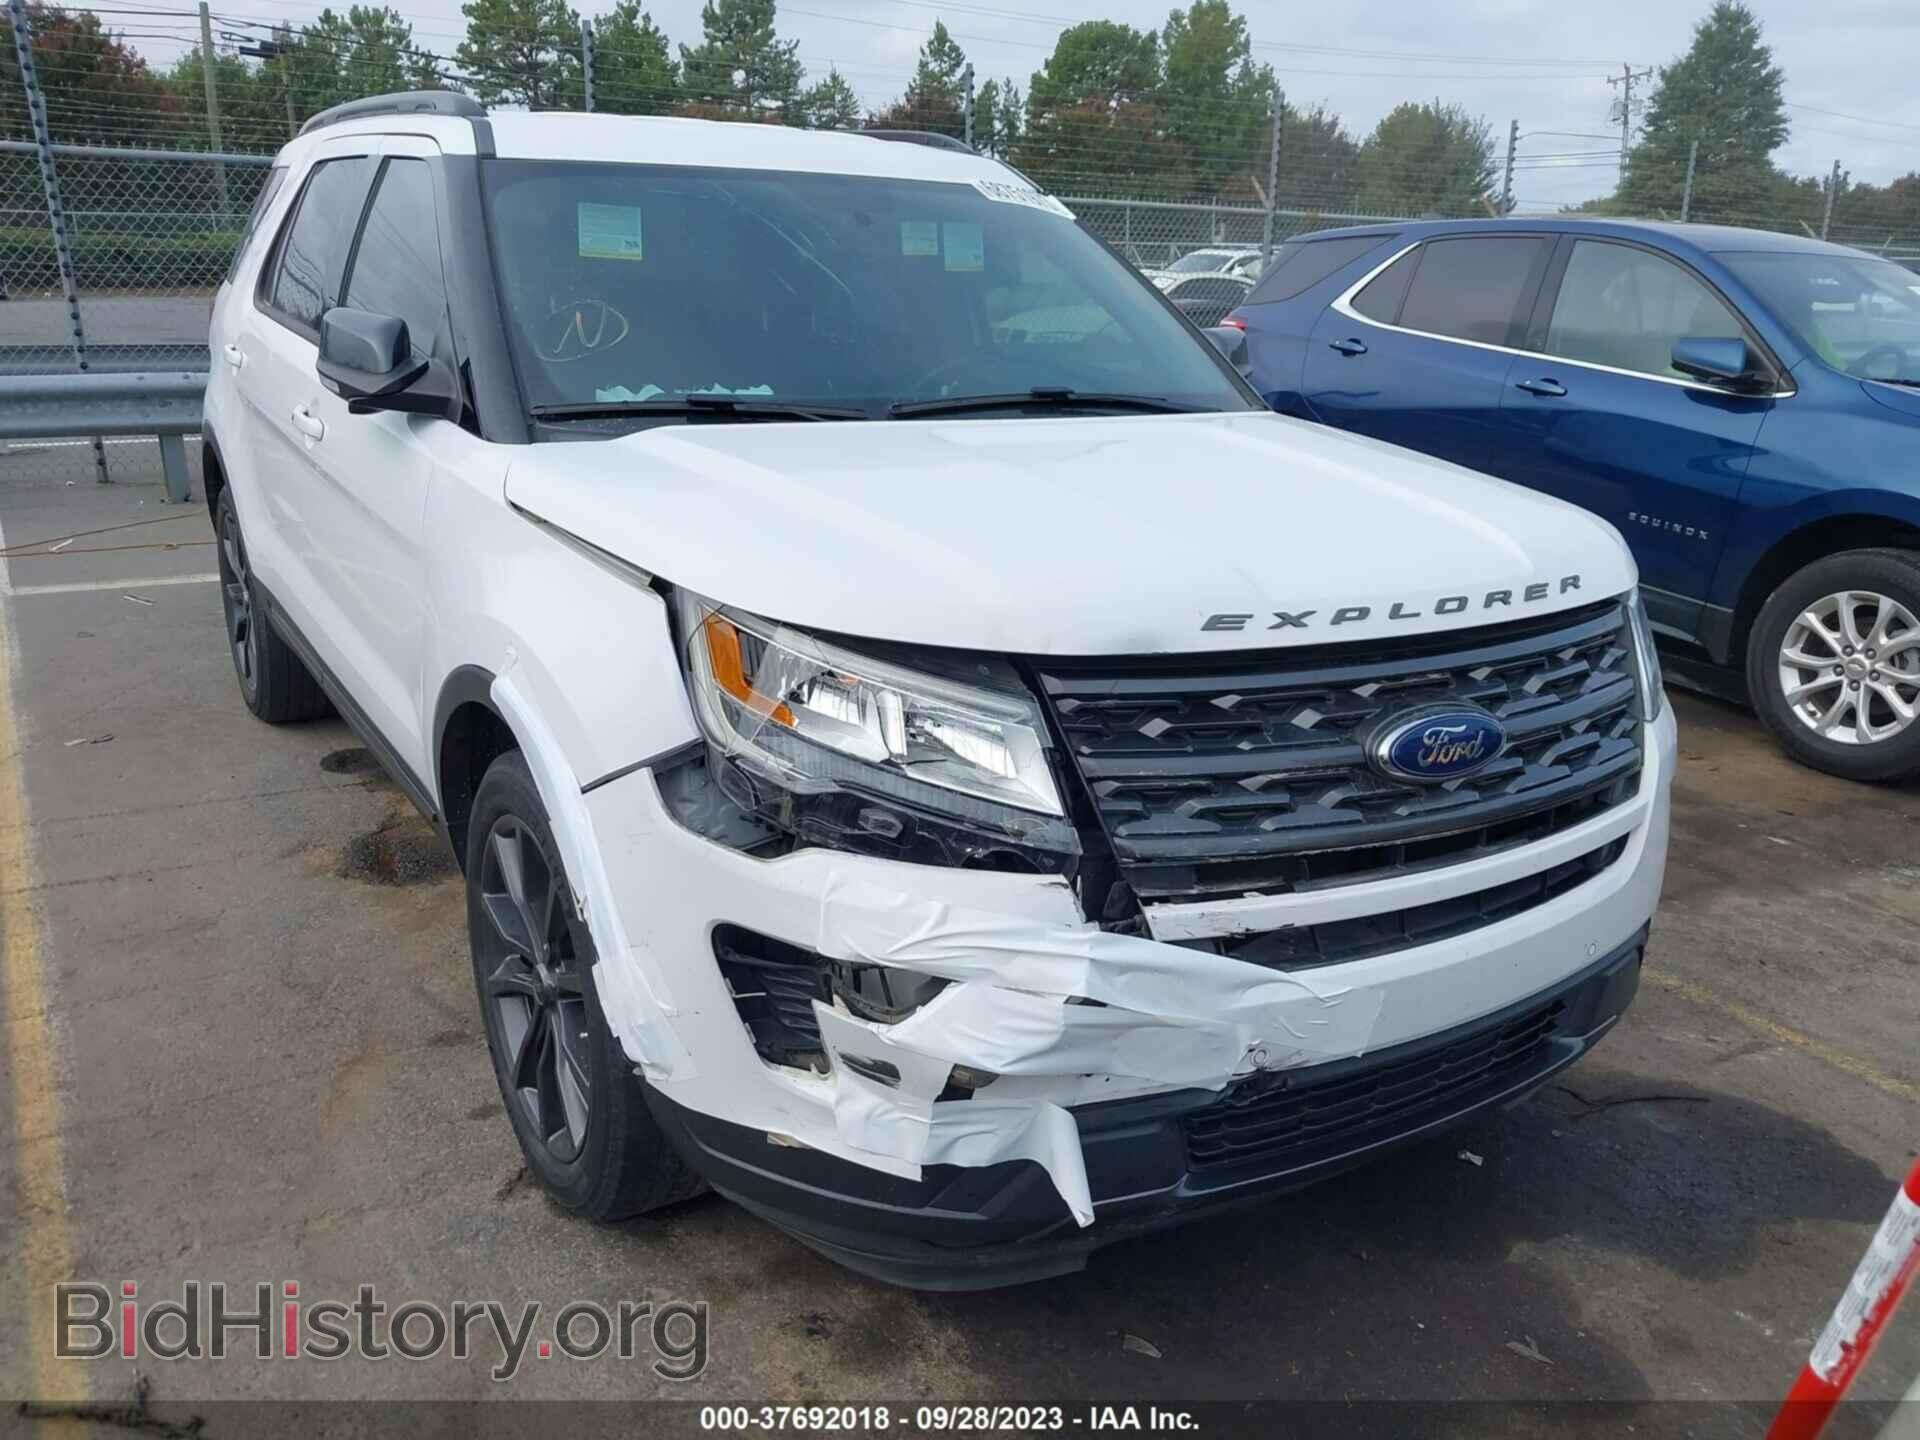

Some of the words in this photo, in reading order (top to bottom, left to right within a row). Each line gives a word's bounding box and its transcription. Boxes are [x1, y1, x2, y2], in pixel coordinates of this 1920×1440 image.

[1628, 511, 1709, 540] EQUINOX
[1201, 574, 1583, 632] EXPLORER
[1417, 724, 1485, 768] Ford
